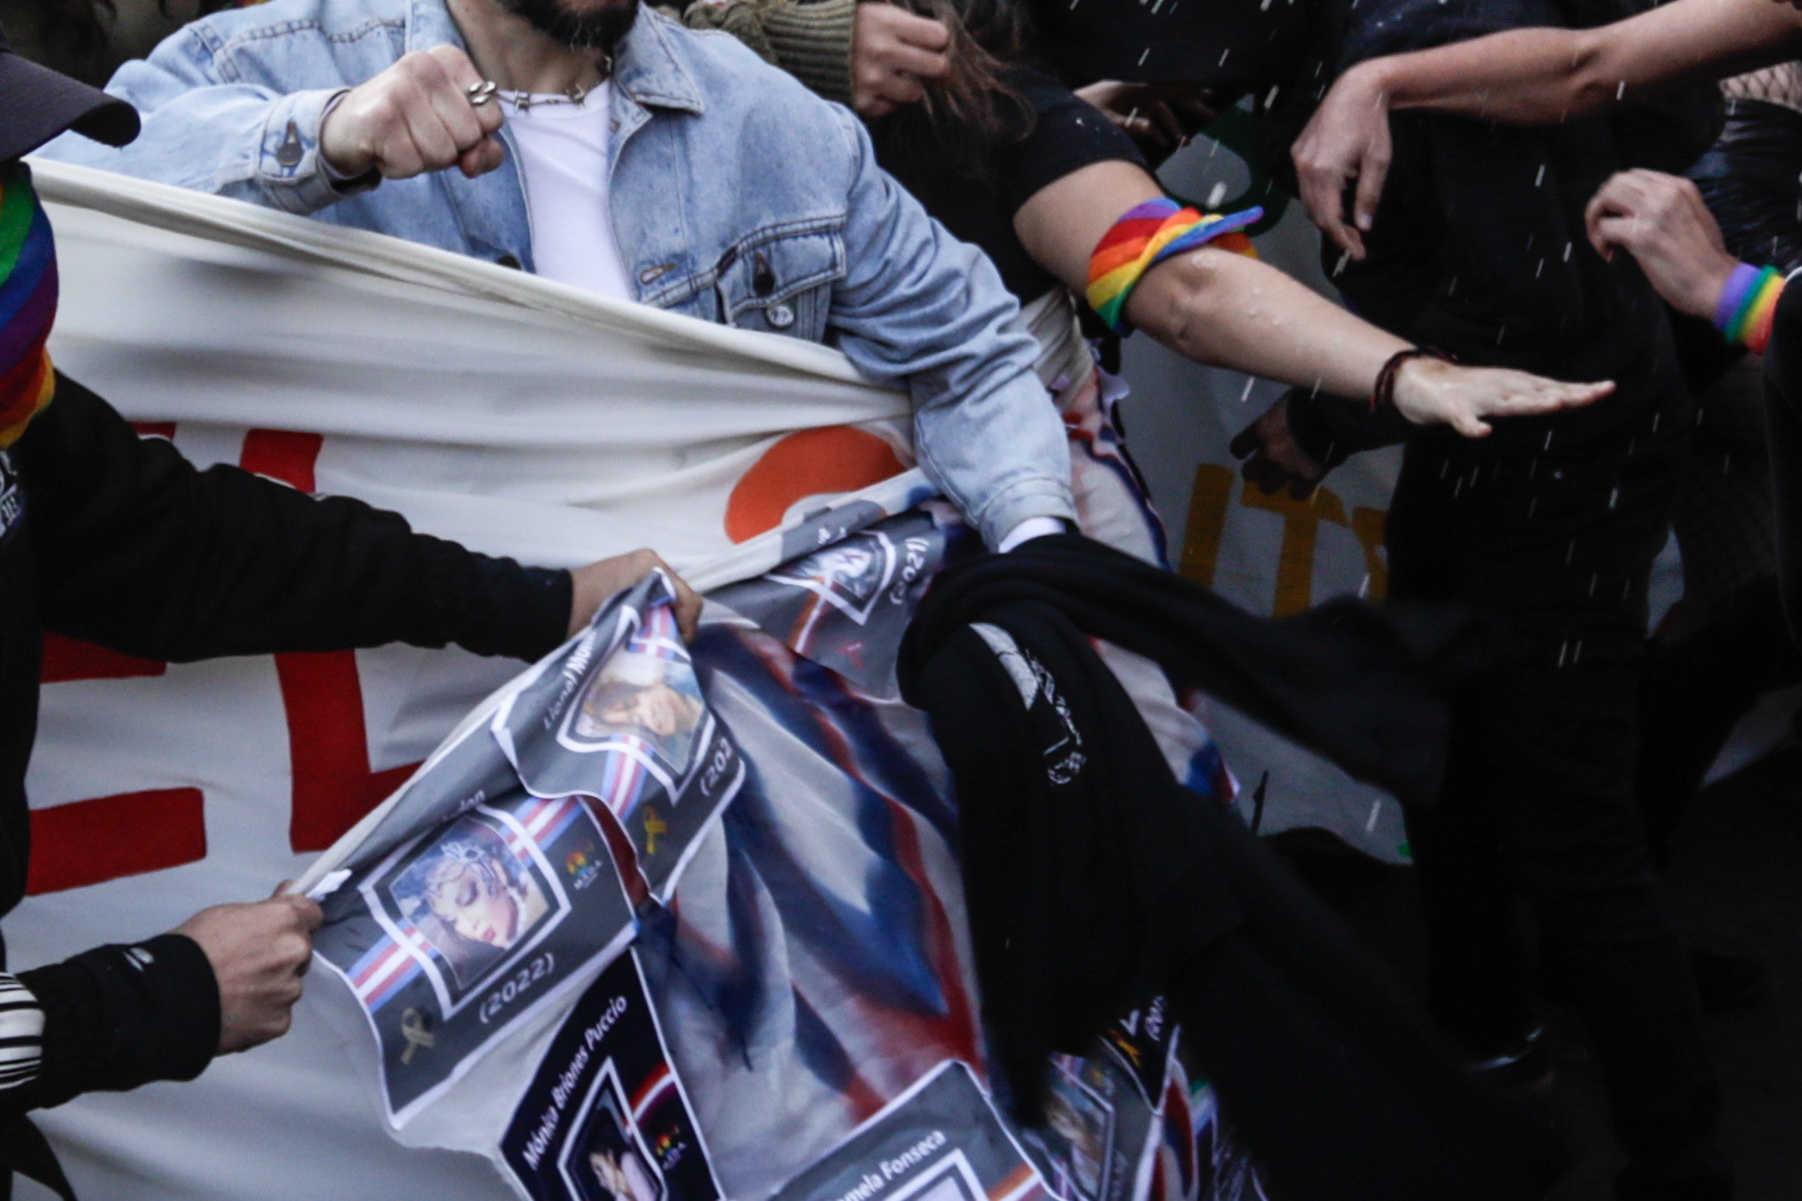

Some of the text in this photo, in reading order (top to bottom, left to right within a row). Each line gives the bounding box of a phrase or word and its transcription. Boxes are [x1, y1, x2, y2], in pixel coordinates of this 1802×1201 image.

[479, 952, 555, 1024] (2022)
[522, 995, 628, 1172] Mónica Briones Puccio
[878, 1129, 947, 1181] Fonseca
